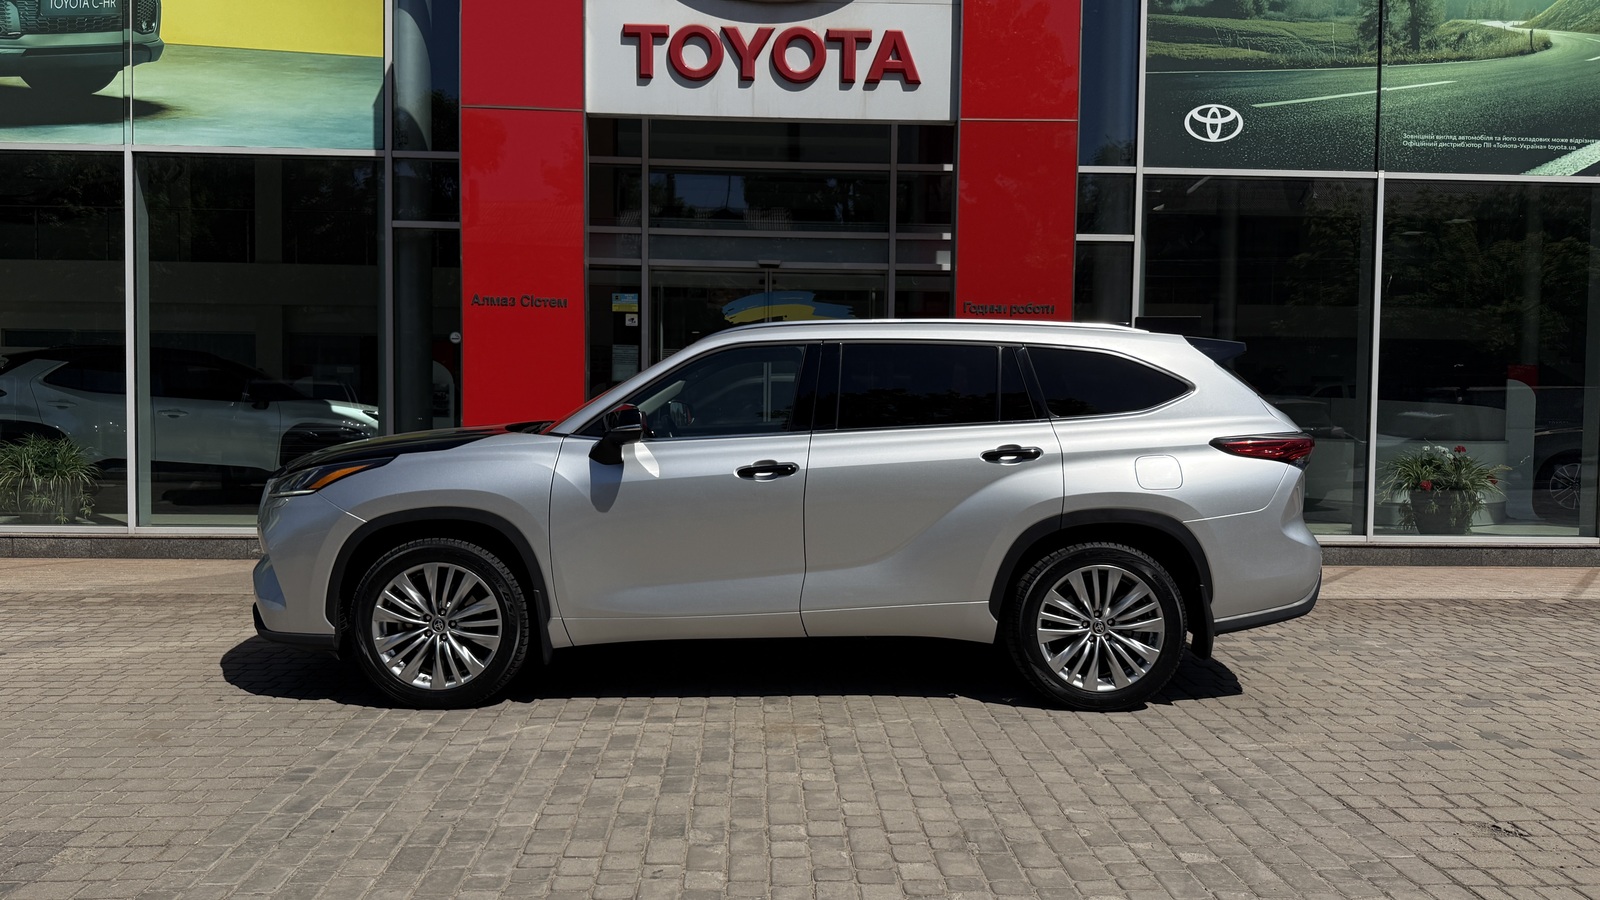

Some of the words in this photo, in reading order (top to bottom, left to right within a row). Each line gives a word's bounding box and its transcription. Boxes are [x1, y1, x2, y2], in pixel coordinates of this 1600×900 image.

[622, 23, 922, 84] TOYOTA
[1402, 132, 1435, 140] Зовнішній
[1548, 143, 1577, 151] toyota.ua
[471, 293, 517, 307] Алмаз
[520, 294, 568, 308] Сістем
[963, 301, 1008, 316] Години
[1009, 302, 1055, 317] роботи
